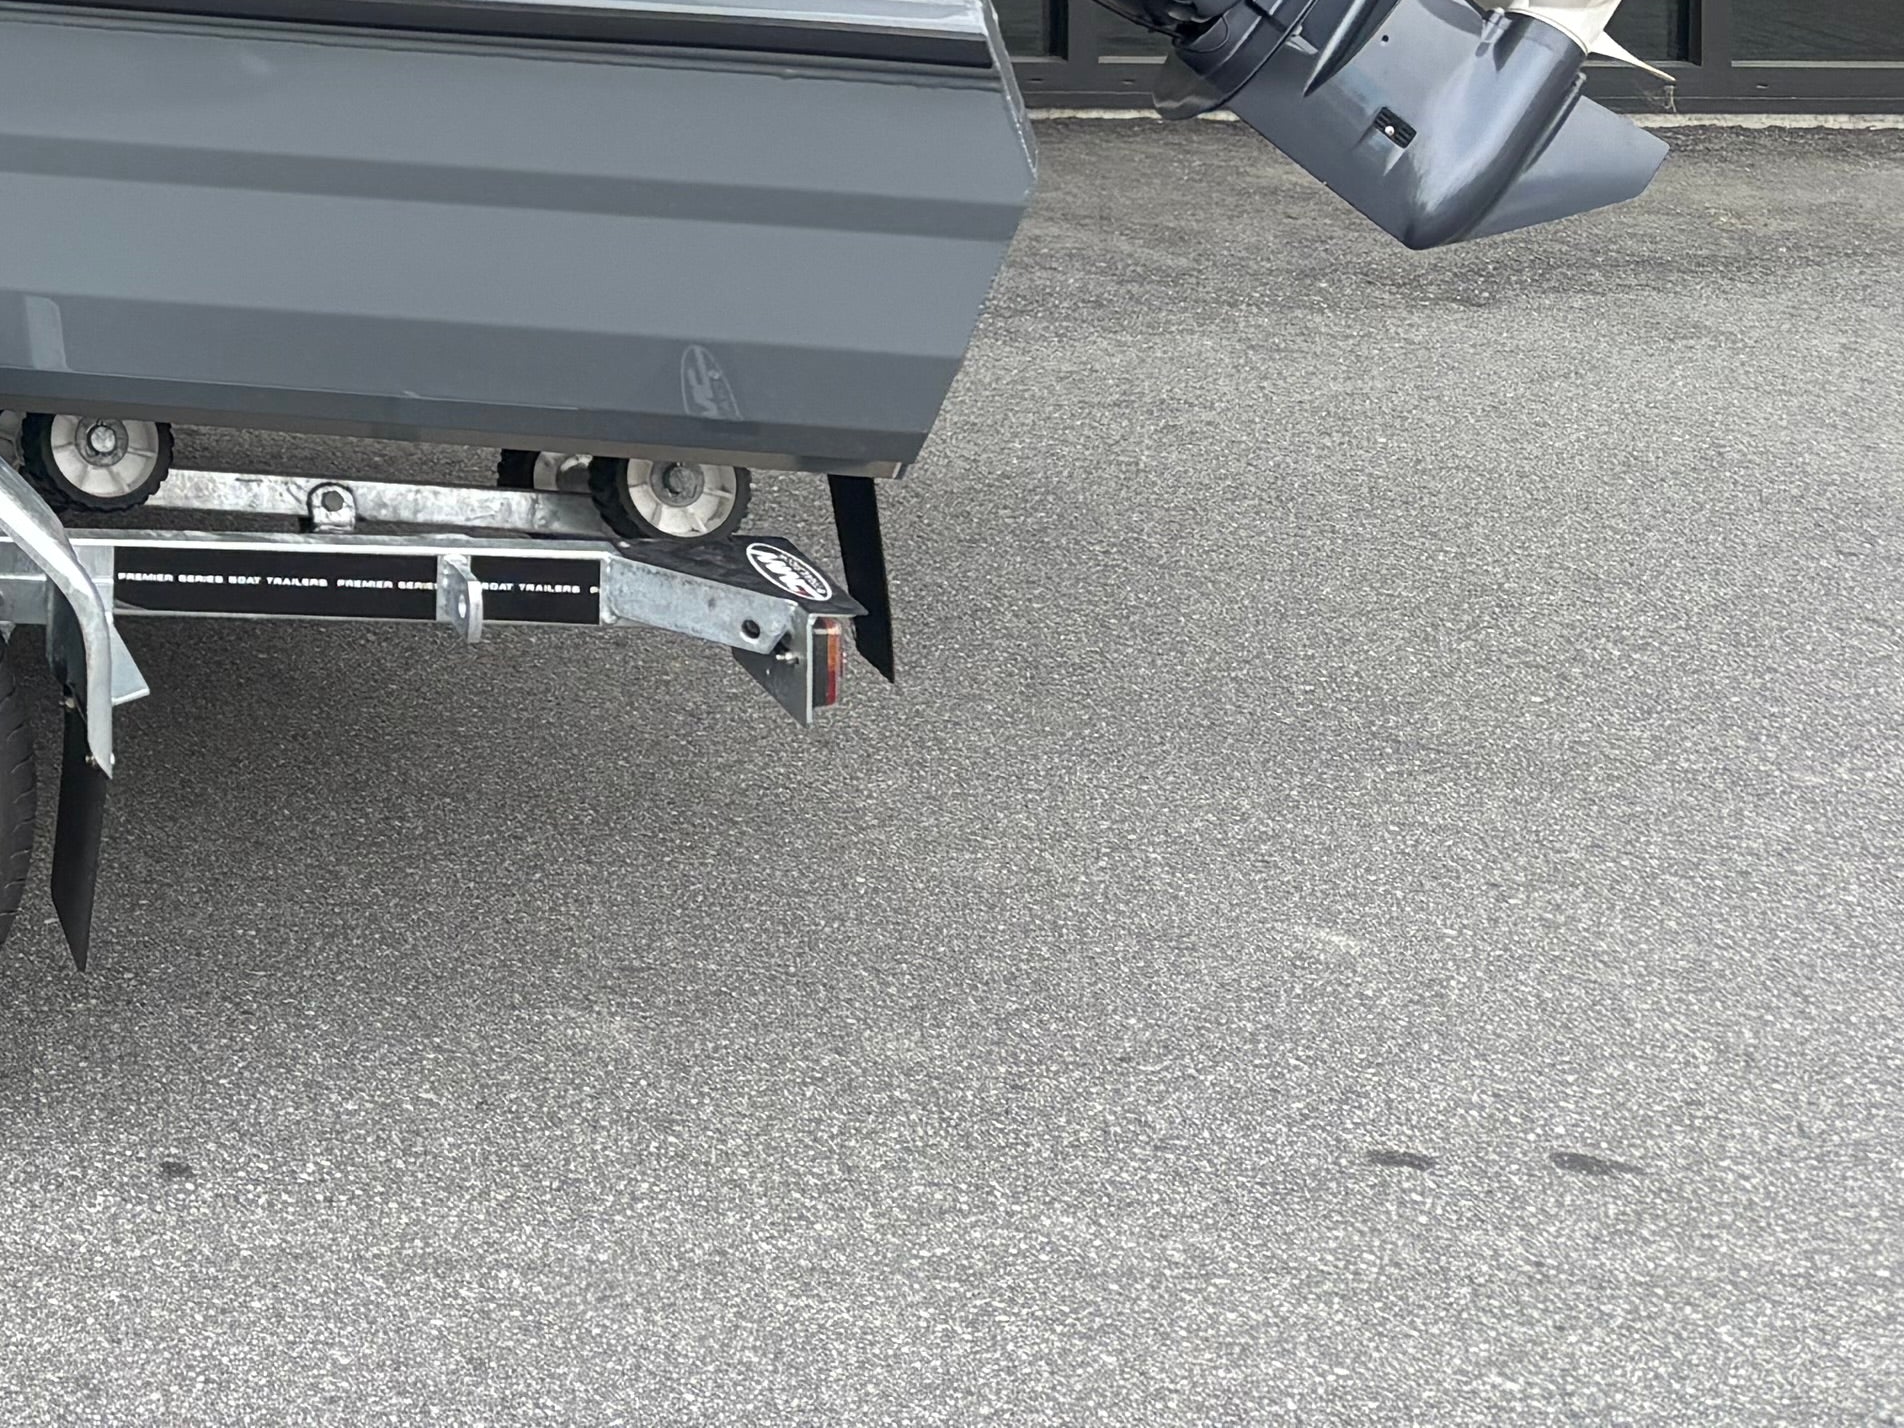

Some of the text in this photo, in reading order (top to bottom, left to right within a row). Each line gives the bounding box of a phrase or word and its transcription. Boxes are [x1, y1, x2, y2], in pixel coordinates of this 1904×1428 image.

[117, 572, 174, 583] PREMIER
[177, 574, 224, 584] SERIES
[228, 575, 262, 585] BOAT
[266, 577, 328, 587] TRAILERS
[336, 578, 393, 589] PREMIER
[519, 583, 581, 594] TRAILERS
